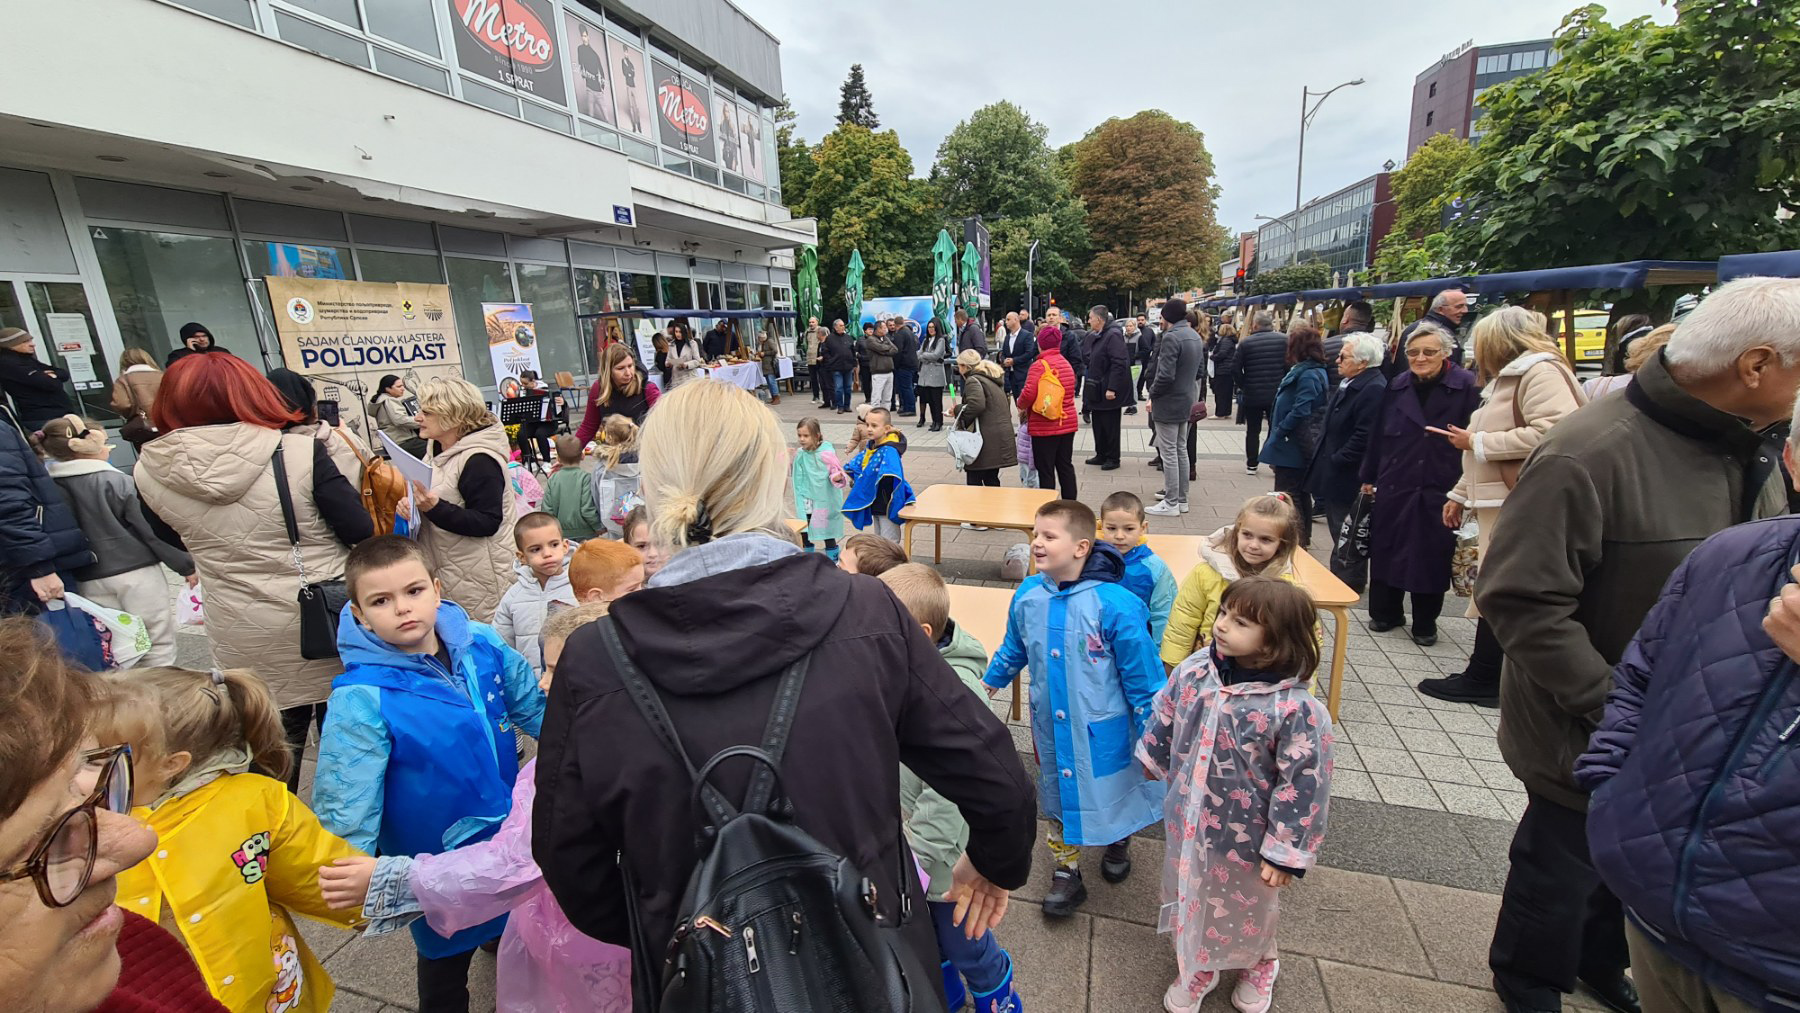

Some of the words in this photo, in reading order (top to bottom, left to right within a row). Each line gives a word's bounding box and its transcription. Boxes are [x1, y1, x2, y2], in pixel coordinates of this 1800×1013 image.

[460, 0, 551, 61] Metro
[498, 70, 504, 81] 1
[505, 72, 534, 92] SPRAT
[658, 85, 707, 131] Metro
[680, 142, 684, 151] 1
[297, 336, 340, 347] SAJAM
[342, 333, 396, 346] ČLANOVA
[397, 332, 445, 344] KLASTERA
[300, 343, 447, 369] POLJOKLAST
